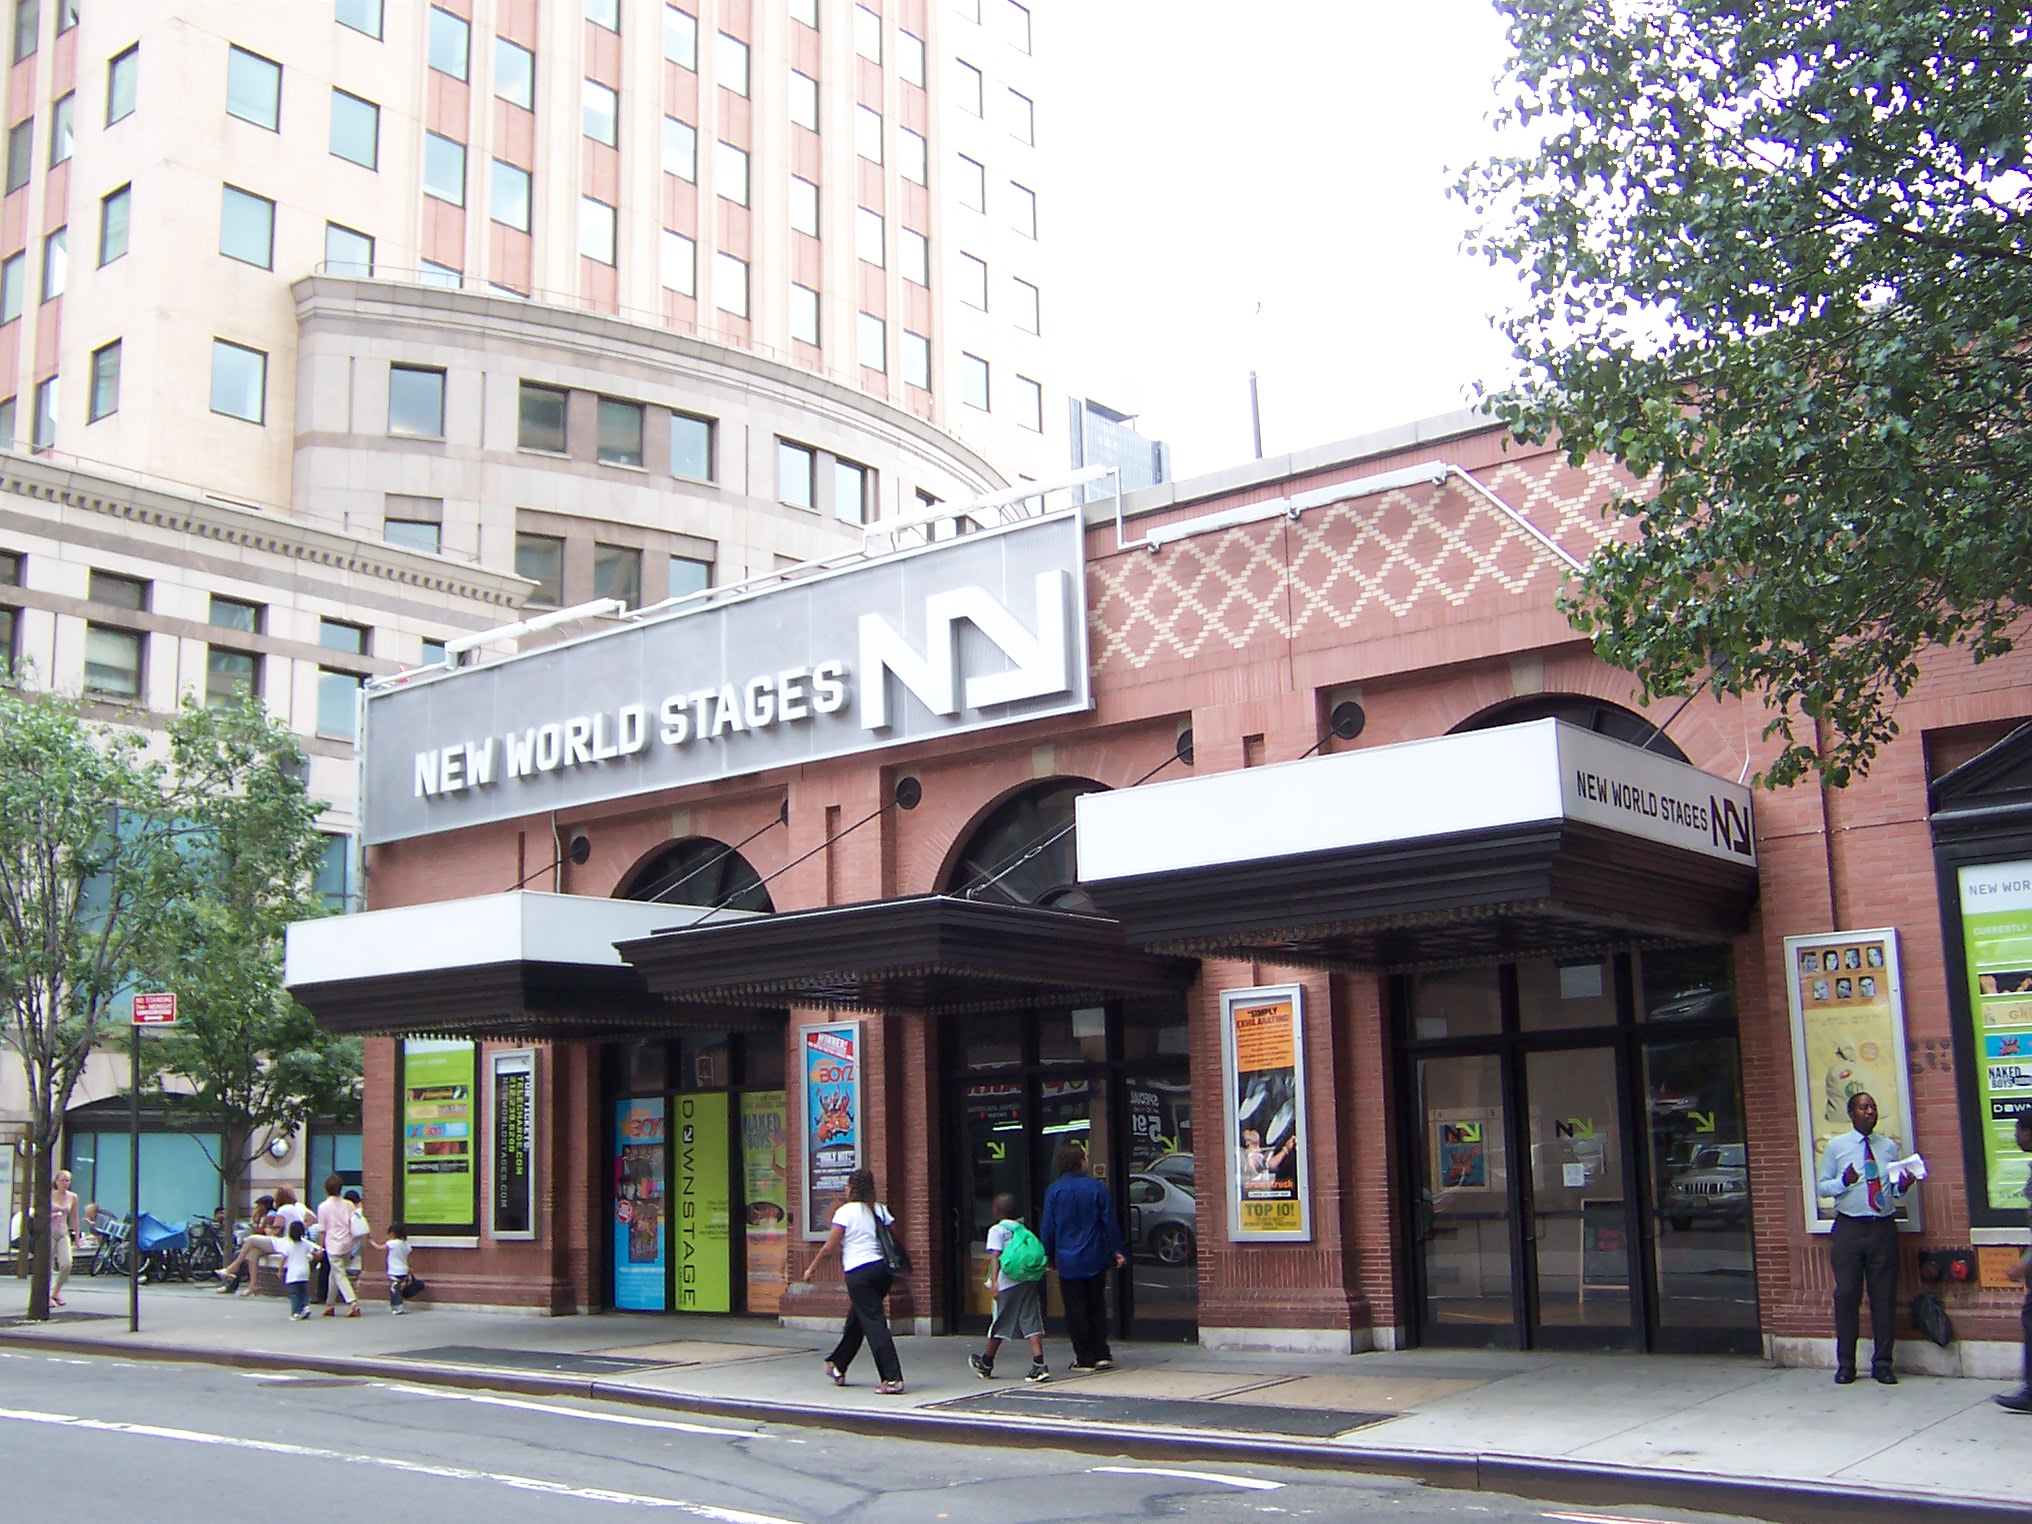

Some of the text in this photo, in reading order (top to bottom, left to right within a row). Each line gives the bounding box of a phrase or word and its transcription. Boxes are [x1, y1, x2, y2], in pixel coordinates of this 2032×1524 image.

[413, 735, 499, 798] NEW
[506, 702, 648, 778] WORLD
[660, 659, 849, 746] STAGES
[1576, 770, 1607, 804] NEW
[1611, 781, 1658, 818] WORLD
[1660, 796, 1708, 832] STAGES
[1969, 883, 1998, 896] NEW
[1988, 1066, 2021, 1080] NAKED
[1245, 1203, 1273, 1217] TOP
